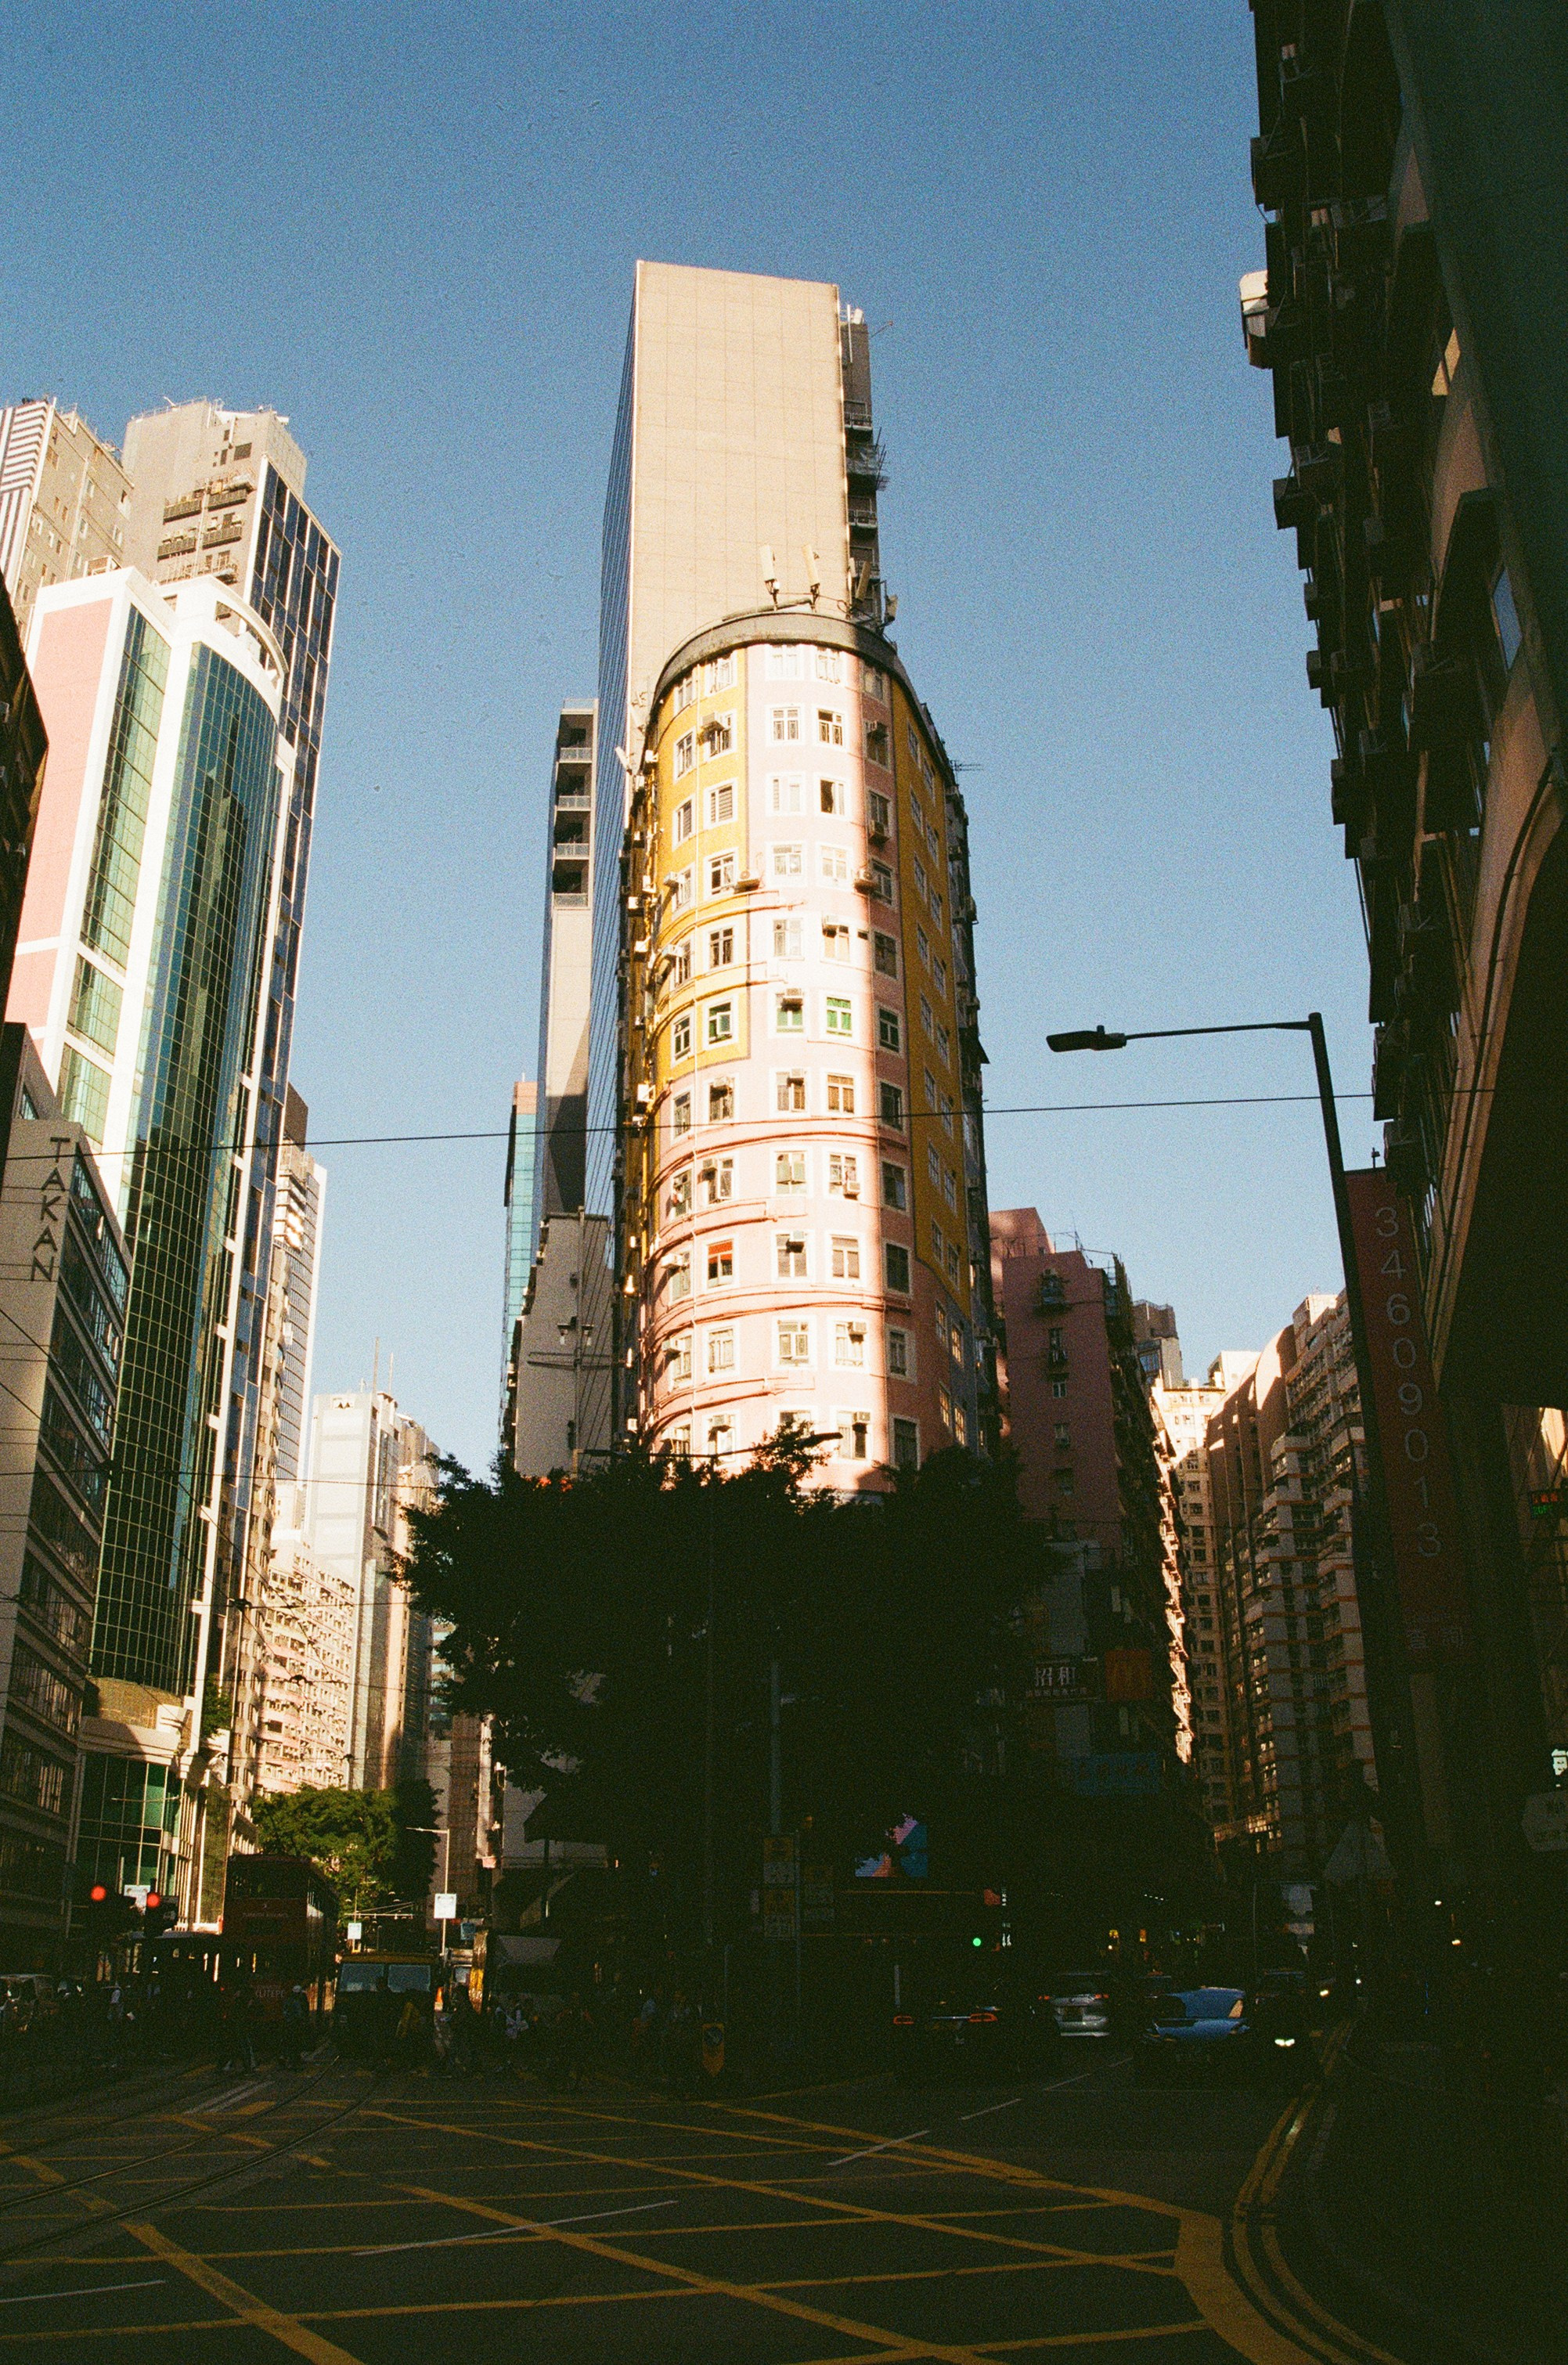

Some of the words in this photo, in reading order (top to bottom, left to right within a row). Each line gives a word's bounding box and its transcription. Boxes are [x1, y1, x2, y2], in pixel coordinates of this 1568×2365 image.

[31, 1137, 70, 1282] TAKAN
[1375, 1206, 1442, 1558] 34609013
[1034, 1666, 1077, 1687] 招租
